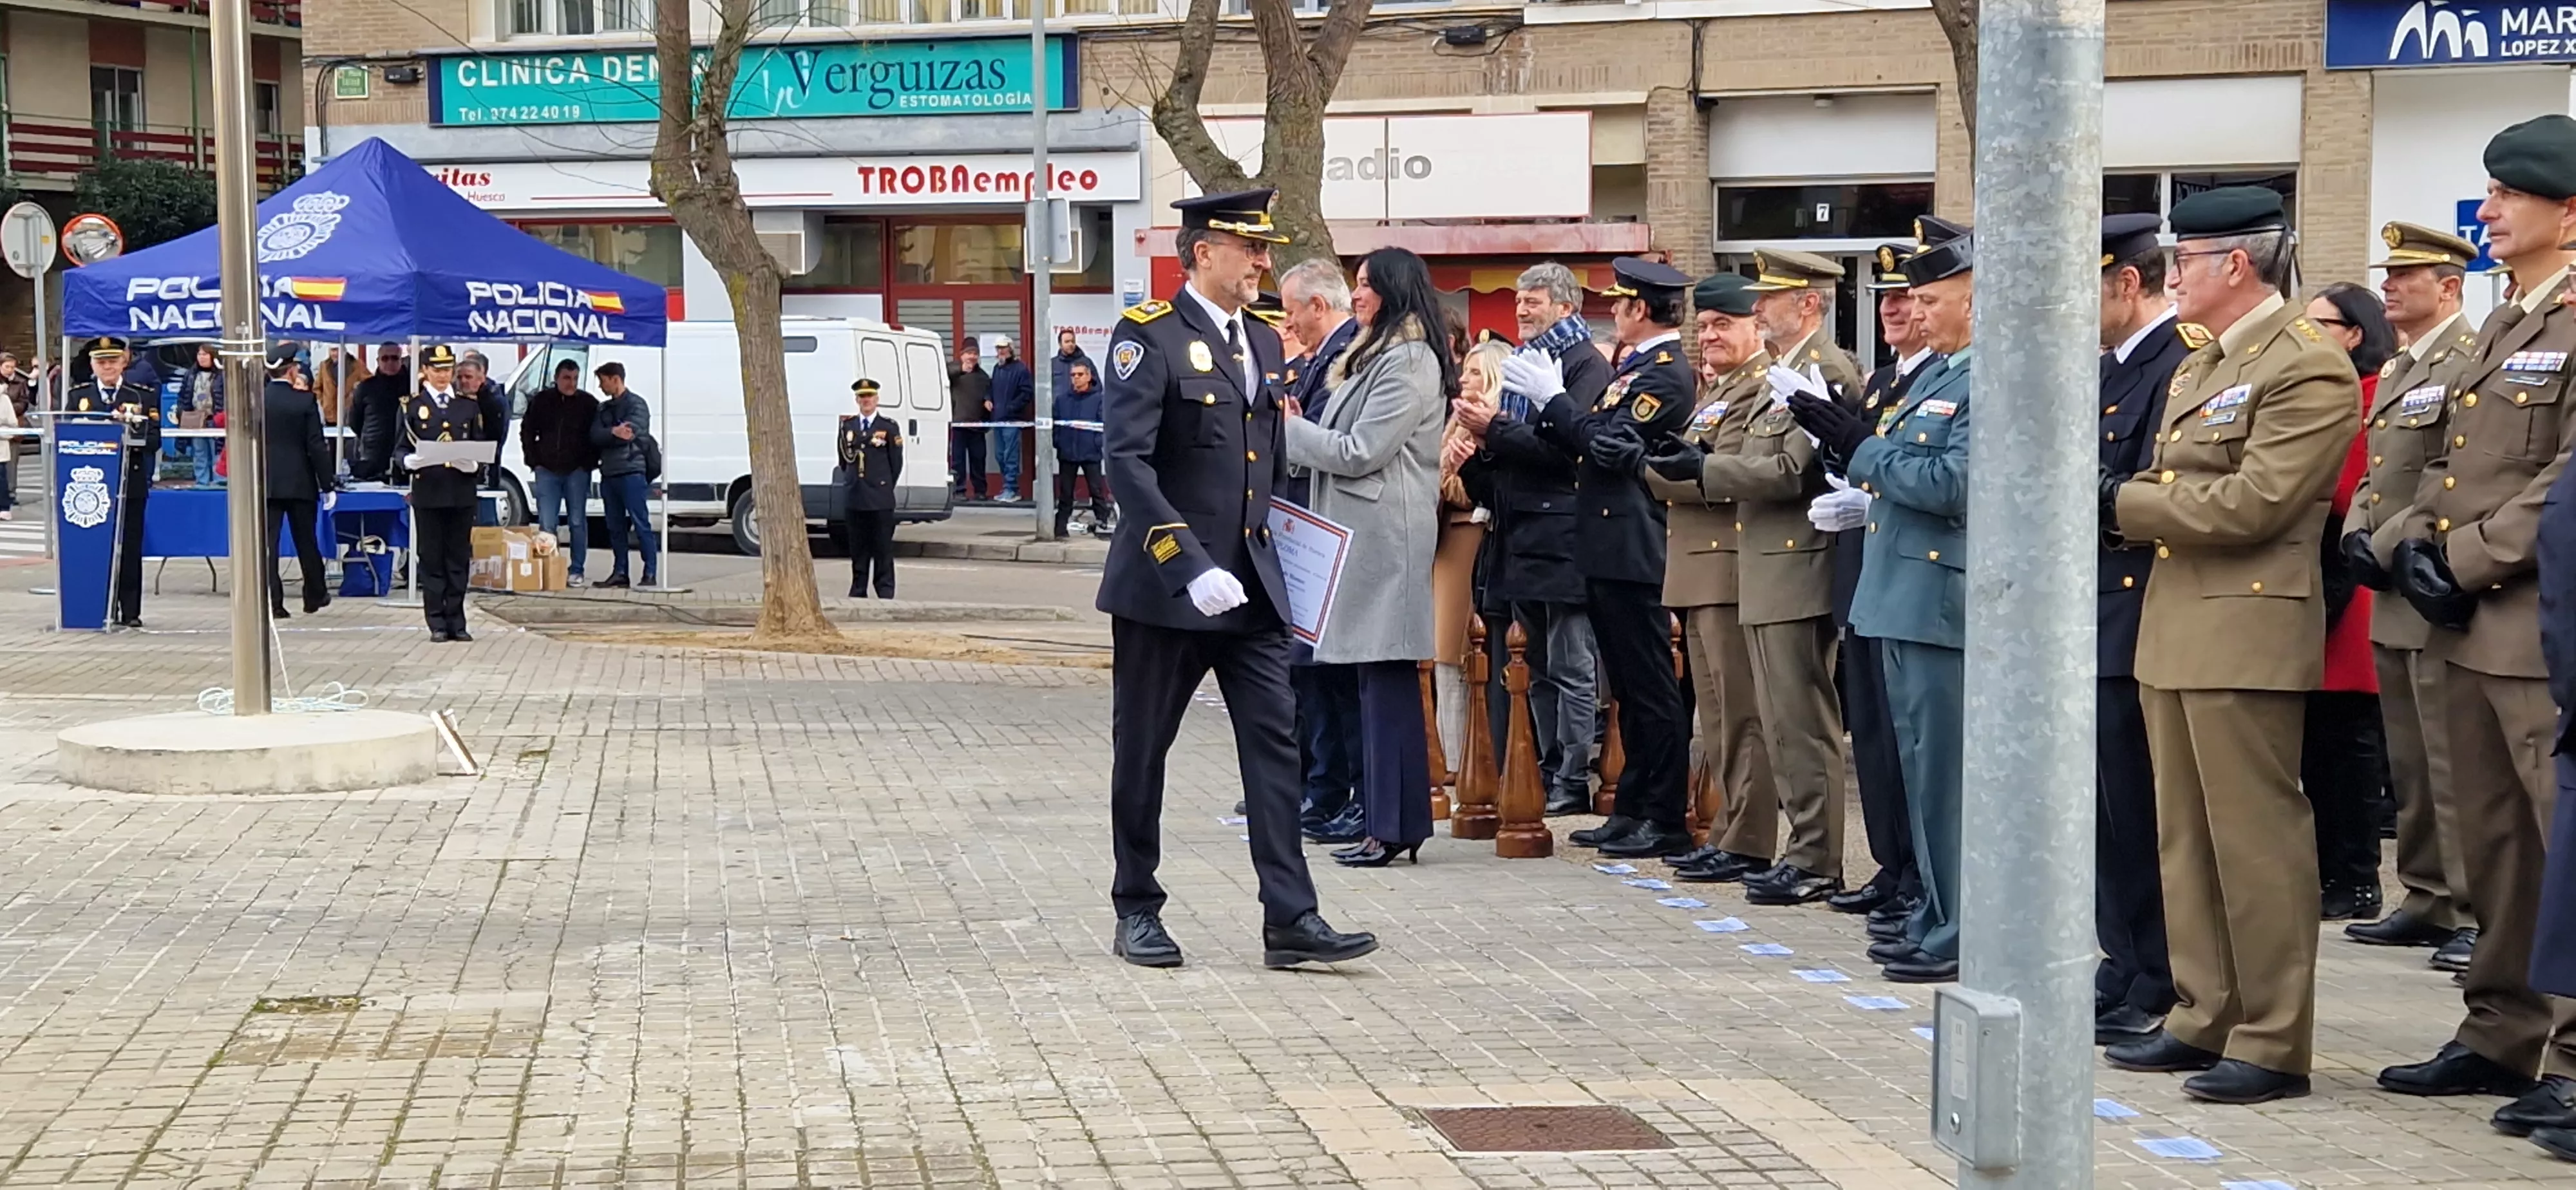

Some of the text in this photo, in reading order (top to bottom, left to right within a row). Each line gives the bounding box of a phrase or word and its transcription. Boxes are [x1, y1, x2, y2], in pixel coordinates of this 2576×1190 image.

[2501, 6, 2576, 36] MAR
[2501, 39, 2561, 57] LOPEZ
[458, 57, 590, 87] CLINICA
[784, 44, 1007, 109] Verguizas
[459, 108, 487, 121] Tel.
[1323, 147, 1432, 181] adio
[1819, 205, 1827, 219] 7
[126, 275, 299, 301] POLIA
[466, 281, 593, 310] POLICIA
[128, 302, 346, 331] NACINAL
[468, 309, 624, 340] NACIONAL
